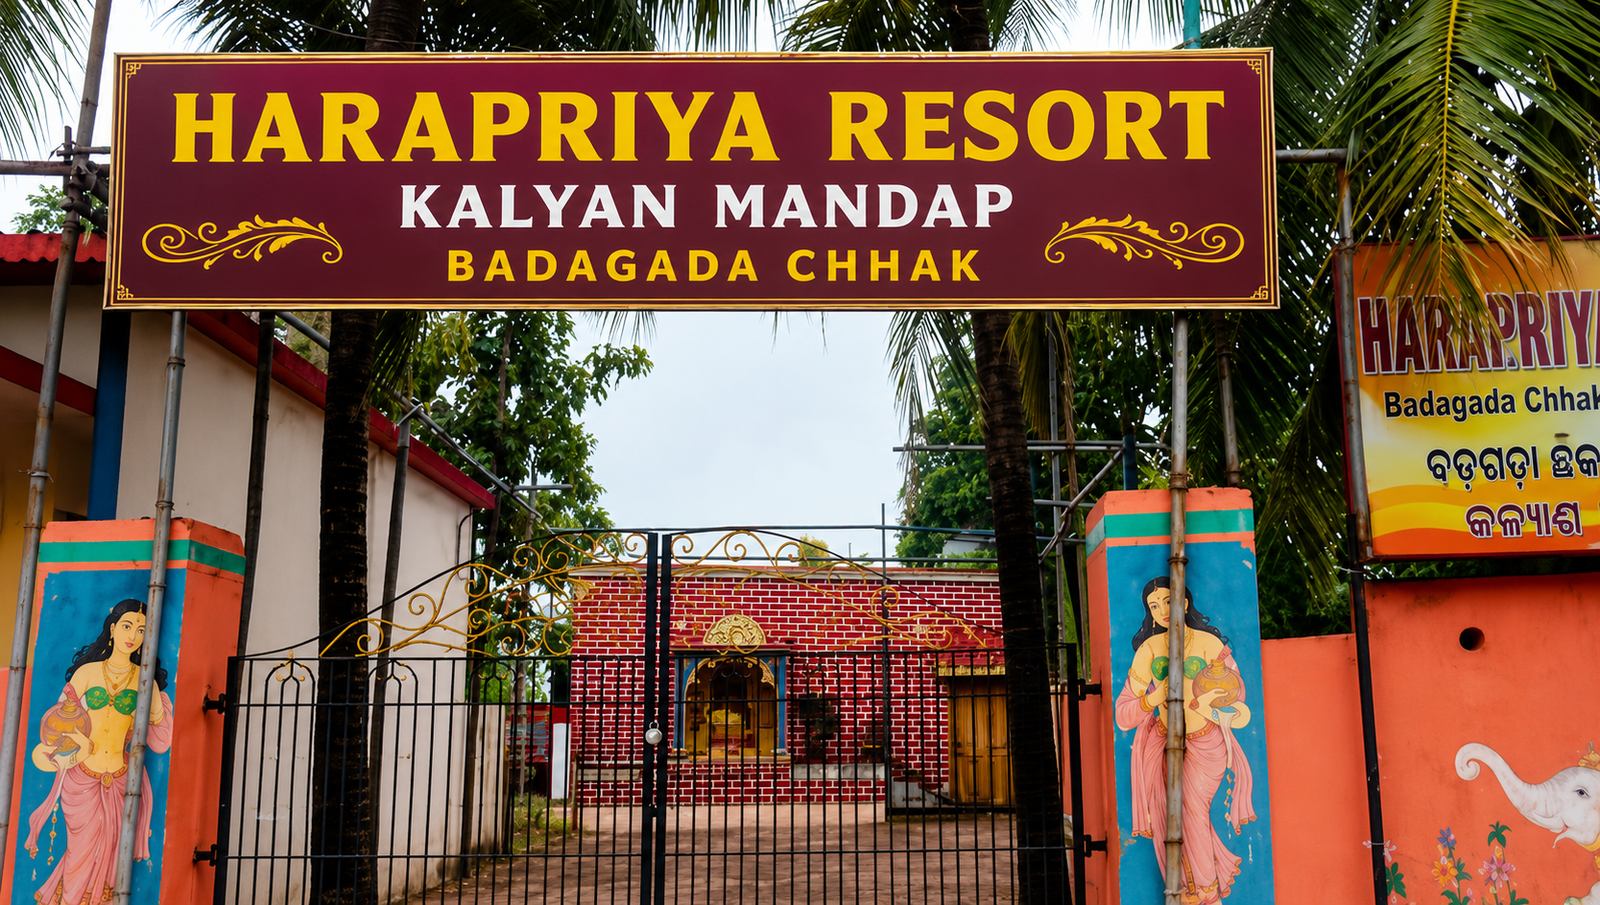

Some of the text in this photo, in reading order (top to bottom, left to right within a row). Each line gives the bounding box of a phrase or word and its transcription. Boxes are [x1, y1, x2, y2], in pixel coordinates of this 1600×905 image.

[171, 89, 1225, 163] HARAPRIYA RESORT
[399, 183, 1013, 229] KALYAN MANDAP
[447, 249, 981, 282] BADAGADA CHHAK
[1357, 289, 1600, 374] HARAPRIY
[1384, 387, 1516, 422] Badagada
